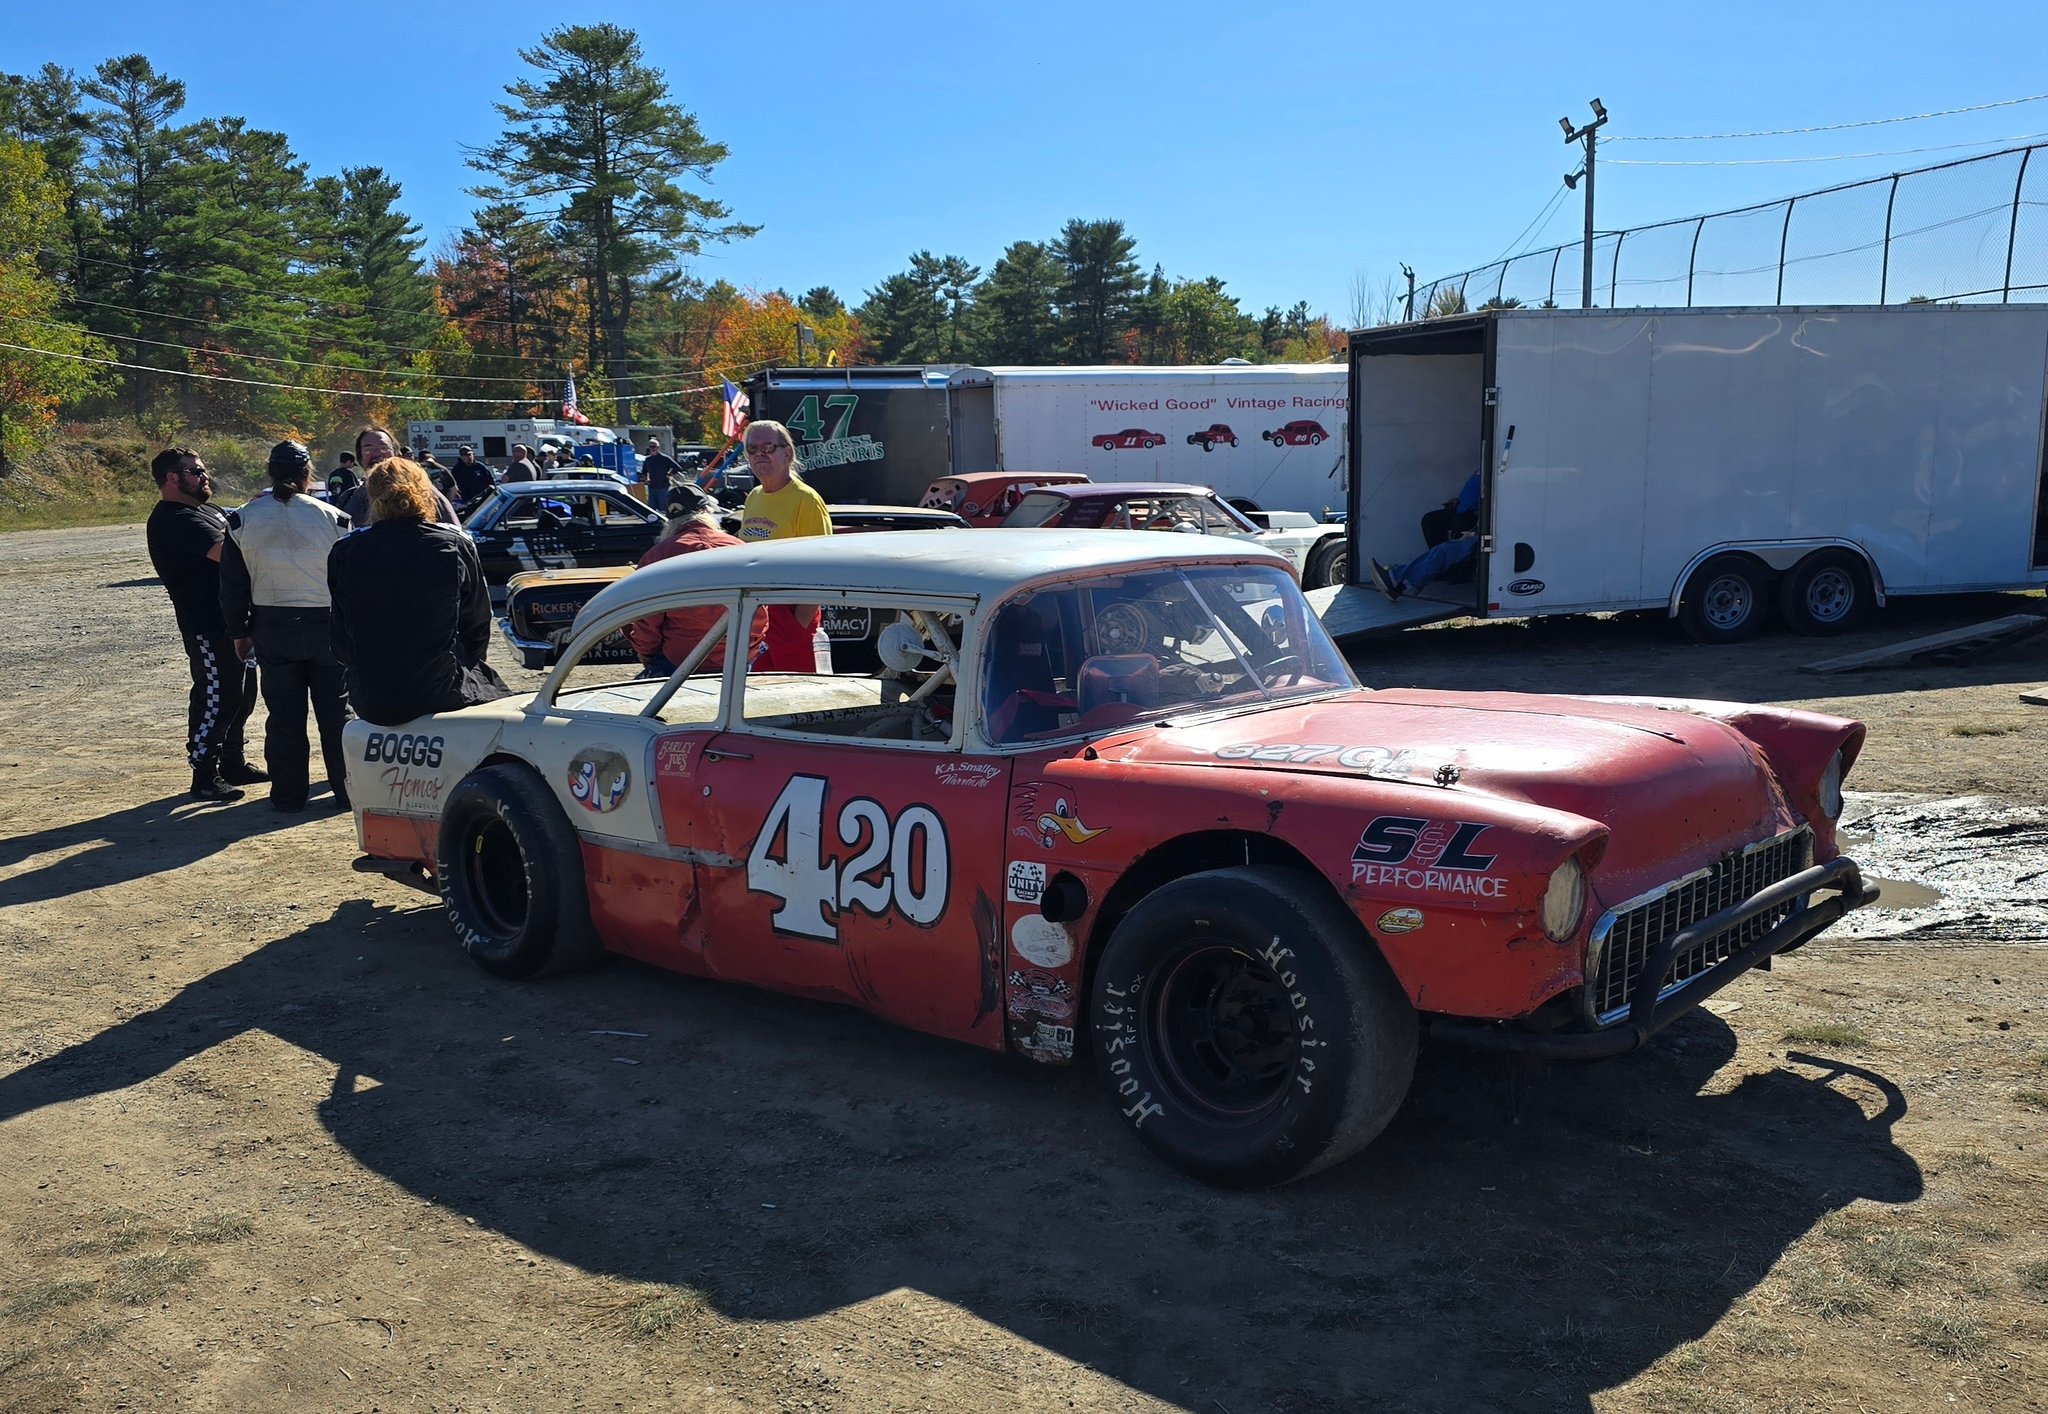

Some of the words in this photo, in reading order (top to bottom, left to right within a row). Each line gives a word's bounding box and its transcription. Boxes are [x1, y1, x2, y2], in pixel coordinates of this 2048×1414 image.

[785, 394, 859, 440] 47
[1090, 399, 1159, 411] "Wicked
[1165, 398, 1217, 410] Good"
[1227, 397, 1286, 410] Vintage
[1292, 396, 1345, 409] Racing
[796, 434, 872, 461] URGESS
[1123, 436, 1137, 446] 11
[532, 602, 582, 615] RICKER'S
[823, 618, 868, 630] RMACY
[363, 732, 445, 769] BOGGS
[658, 741, 696, 760] BARLEY
[1216, 743, 1344, 764] 327
[958, 762, 1001, 779] Smalley
[381, 766, 444, 807] Homes
[1351, 815, 1498, 872] S&L
[747, 772, 951, 945] 420
[1009, 876, 1044, 892] UNITY
[1352, 863, 1510, 898] PERFORMANCE
[1255, 934, 1328, 1095] Hoosier
[1096, 982, 1165, 1129] Hoosier
